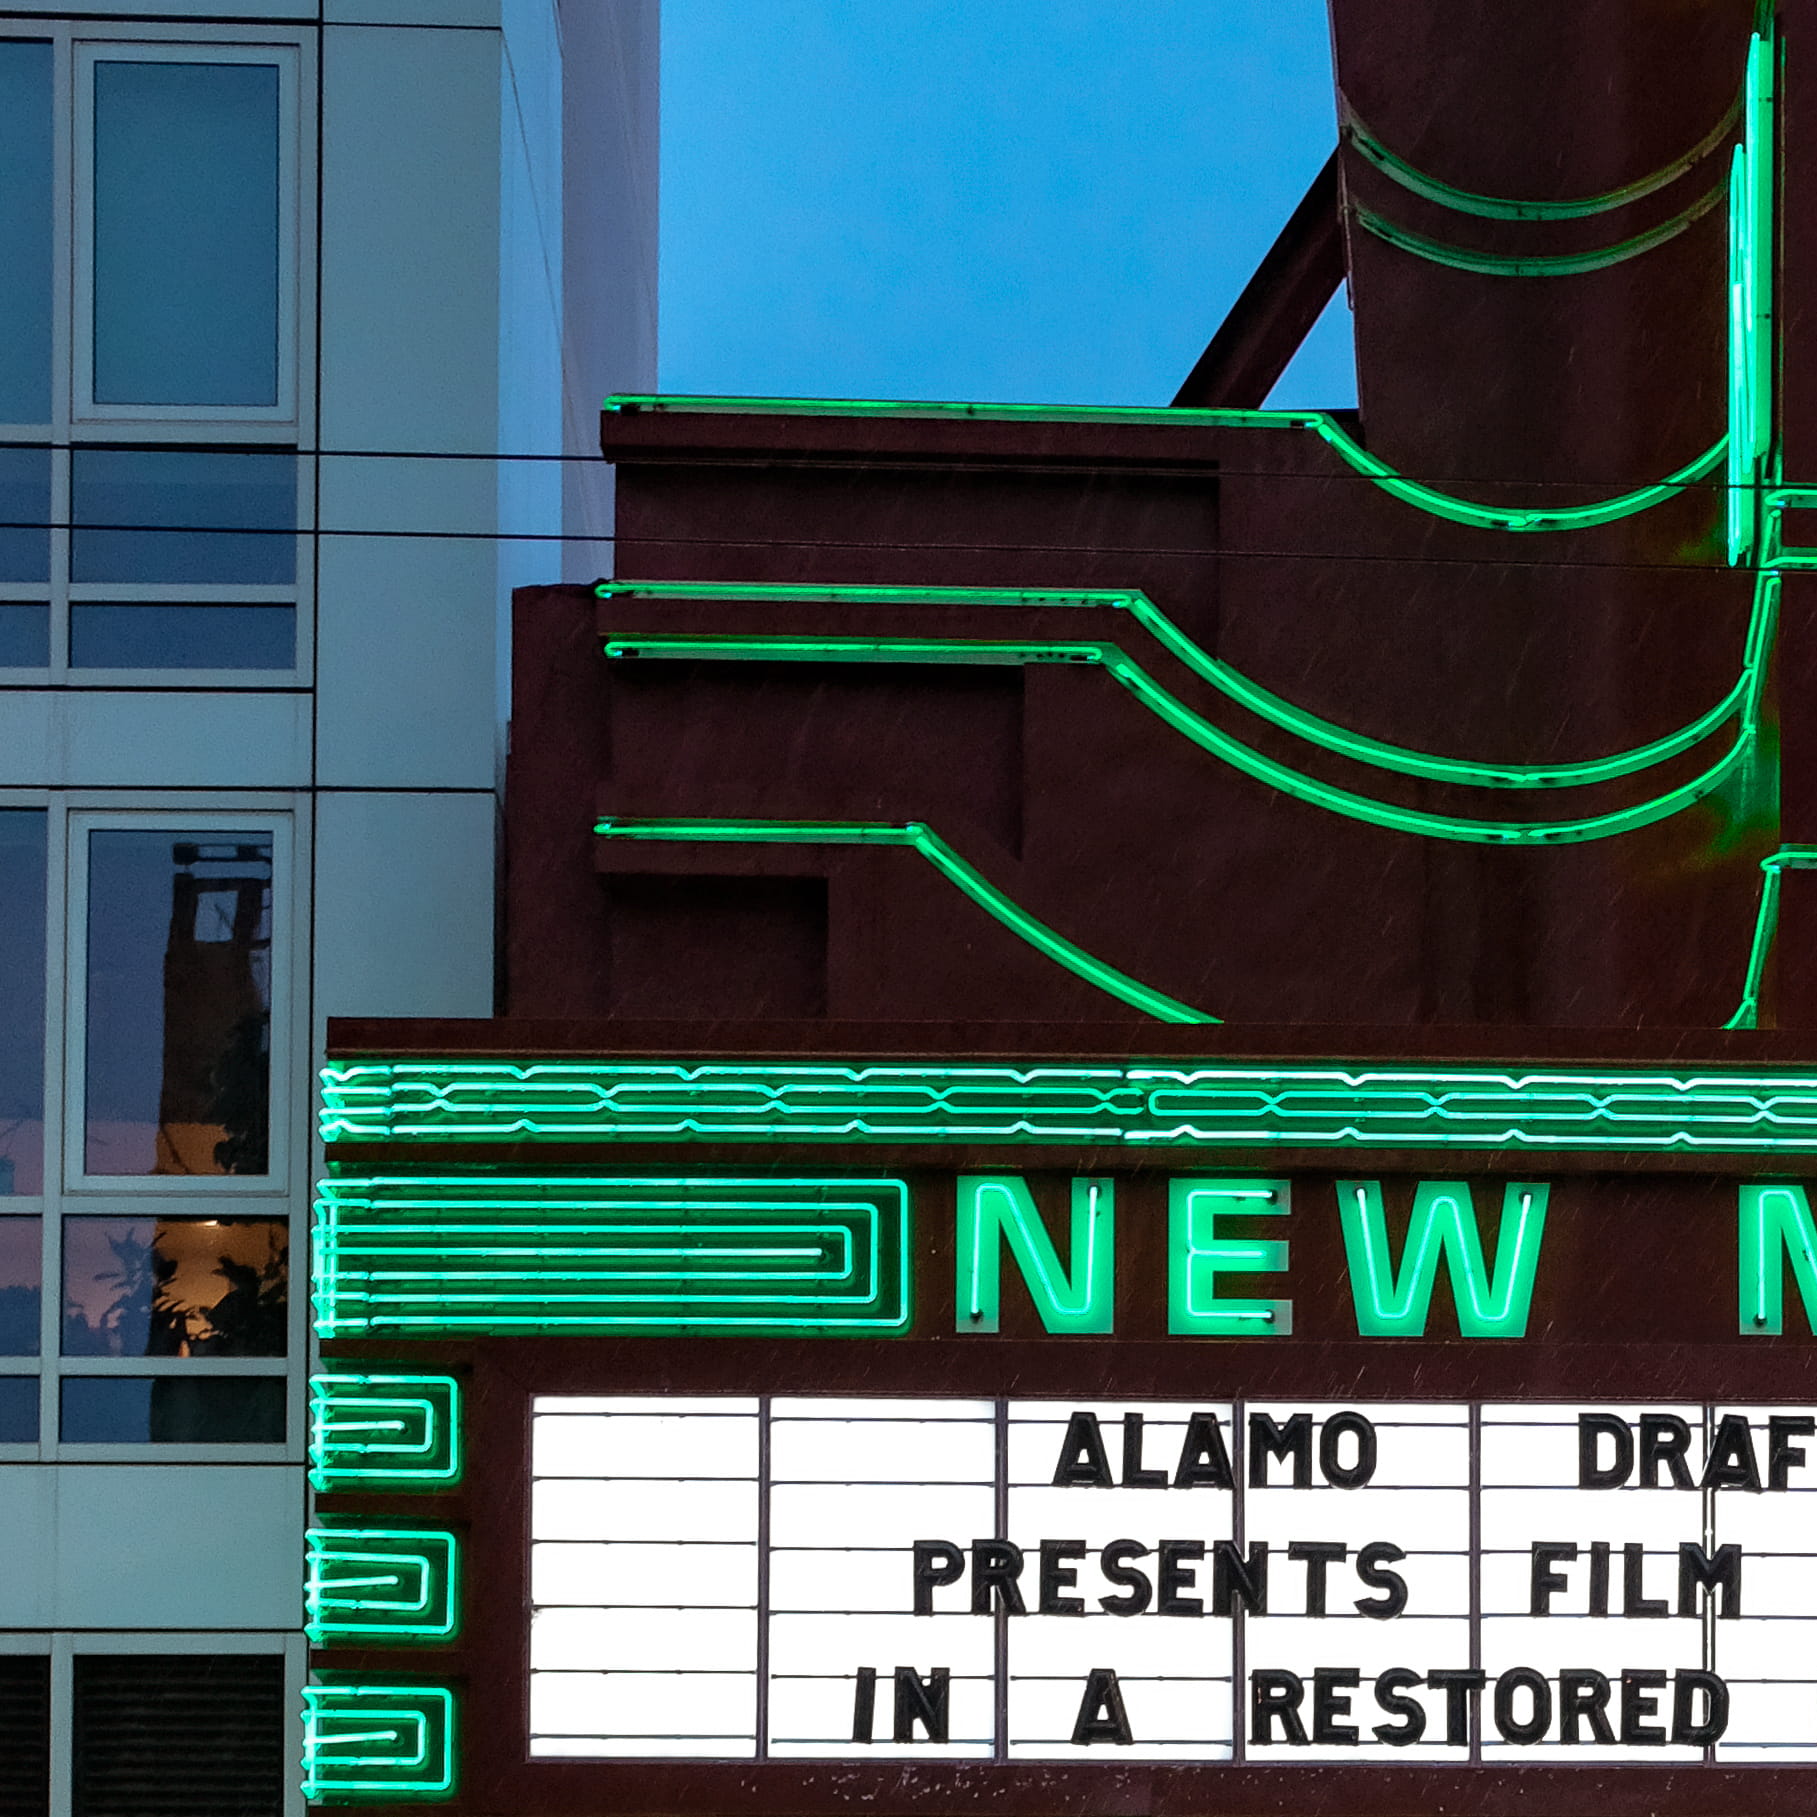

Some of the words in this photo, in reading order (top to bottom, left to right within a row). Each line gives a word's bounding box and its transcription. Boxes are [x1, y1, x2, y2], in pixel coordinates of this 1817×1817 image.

[955, 1176, 1550, 1340] NEW
[1052, 1410, 1378, 1491] ALAMO
[912, 1540, 1409, 1620] PRESENTS
[1530, 1541, 1743, 1620] FILM
[850, 1665, 950, 1745] IN
[1072, 1668, 1135, 1746] A
[1253, 1667, 1731, 1749] RESTORED
